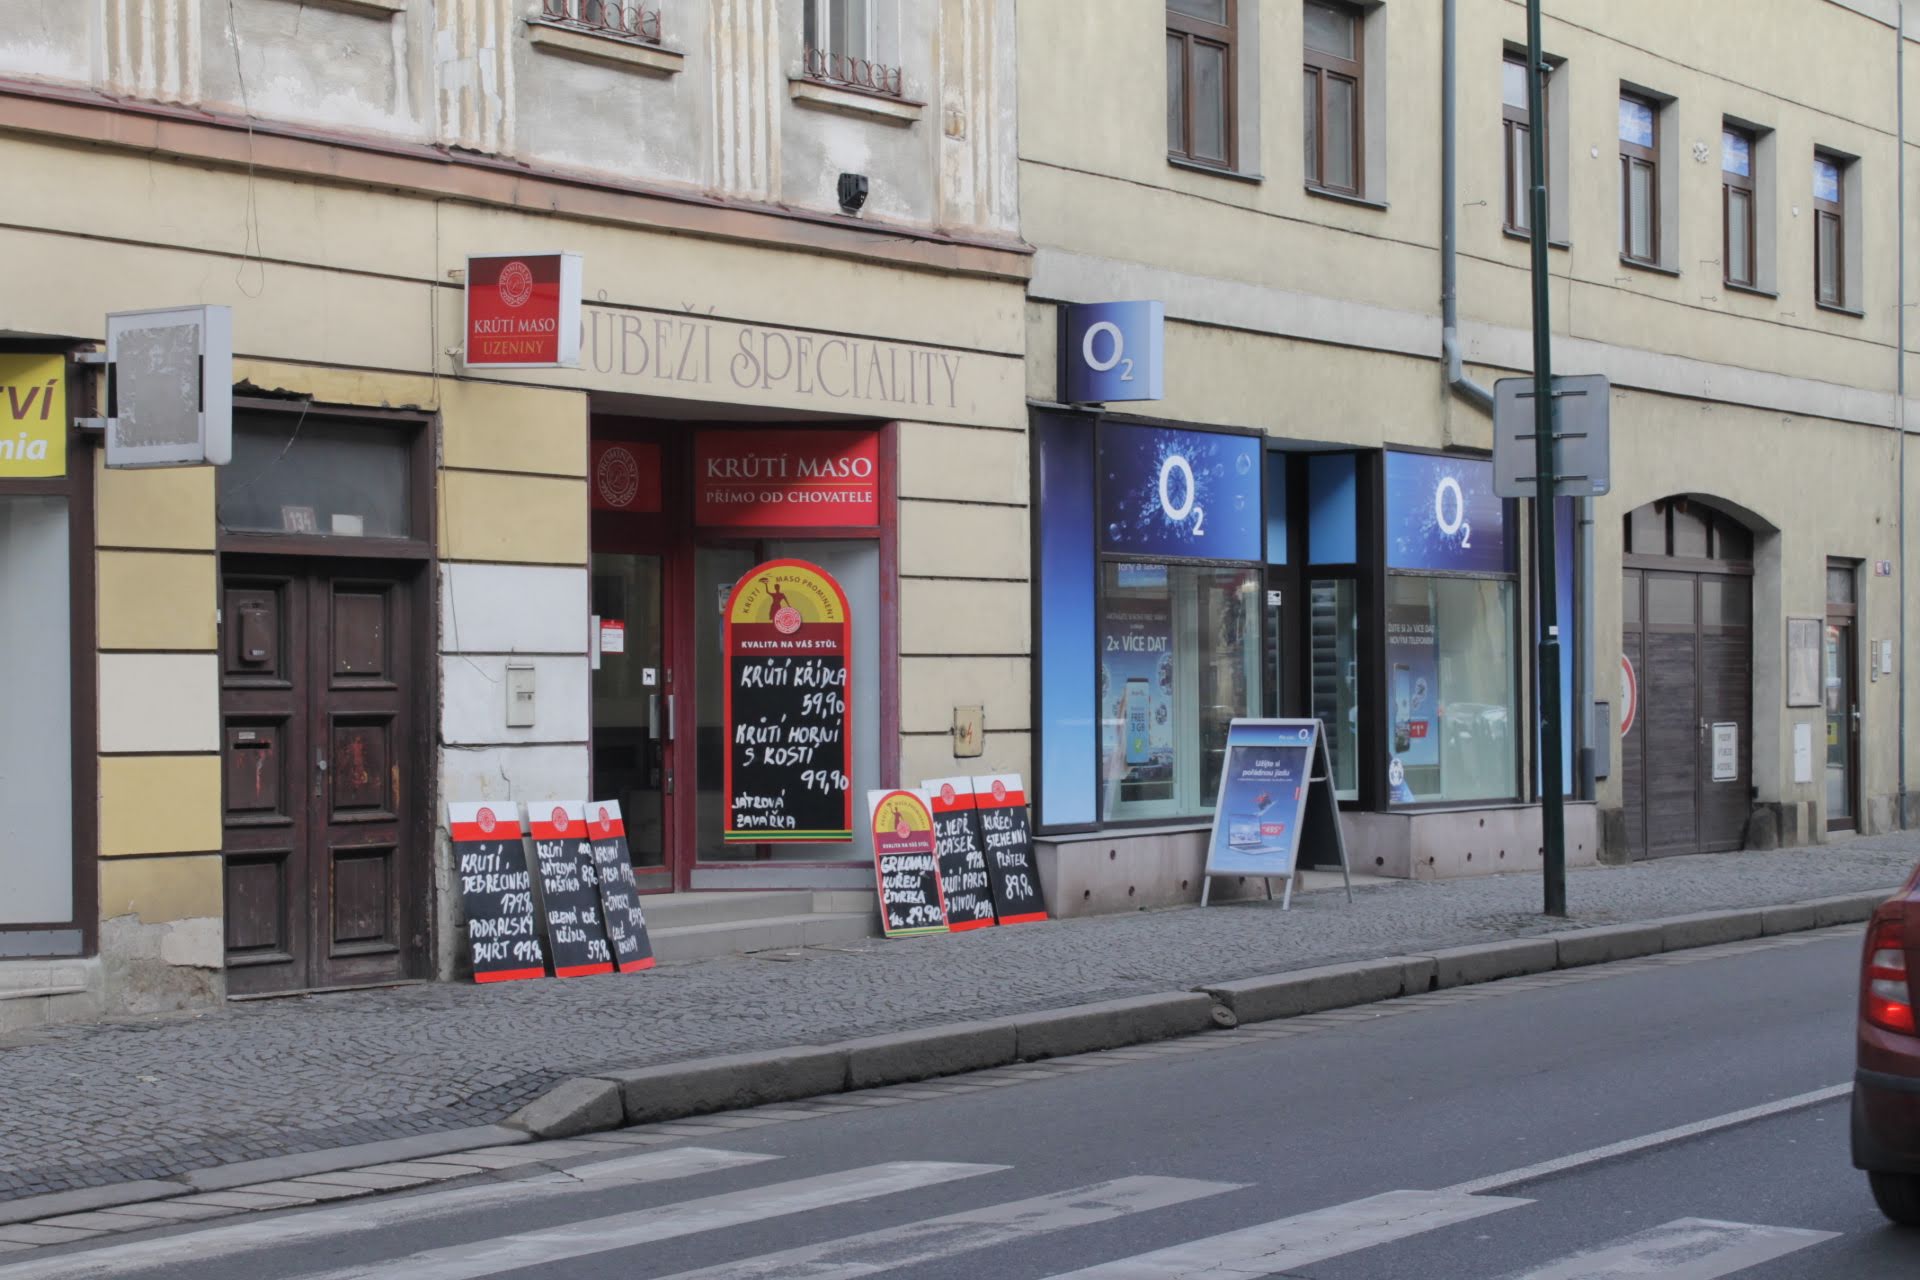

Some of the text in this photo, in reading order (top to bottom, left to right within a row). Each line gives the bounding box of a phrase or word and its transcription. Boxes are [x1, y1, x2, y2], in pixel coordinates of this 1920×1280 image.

[474, 316, 556, 334] KRŮTÍ MASO
[483, 341, 544, 355] UZENINY
[580, 288, 961, 409] ŮBEŽÍ SPECIALITY
[1082, 321, 1134, 381] O2
[706, 453, 873, 478] KRŮTÍ MASO
[760, 491, 784, 503] OD
[787, 491, 874, 503] CHOVATELE
[1158, 454, 1205, 536] O2
[1435, 476, 1472, 549] O2
[775, 575, 801, 584] MASO
[801, 579, 836, 620] PROMINENT
[741, 639, 838, 649] KVALITA NA VÁŠ STŮL
[1106, 632, 1168, 651] 2x VÍCE DAT
[741, 658, 847, 689] KRŮTÍ KŘÍDLA
[801, 691, 846, 719] 59,90
[735, 713, 787, 745] KRŮTÍ
[743, 747, 755, 767] S
[800, 769, 850, 796] 99,90
[461, 844, 503, 874] KRŮTÍ
